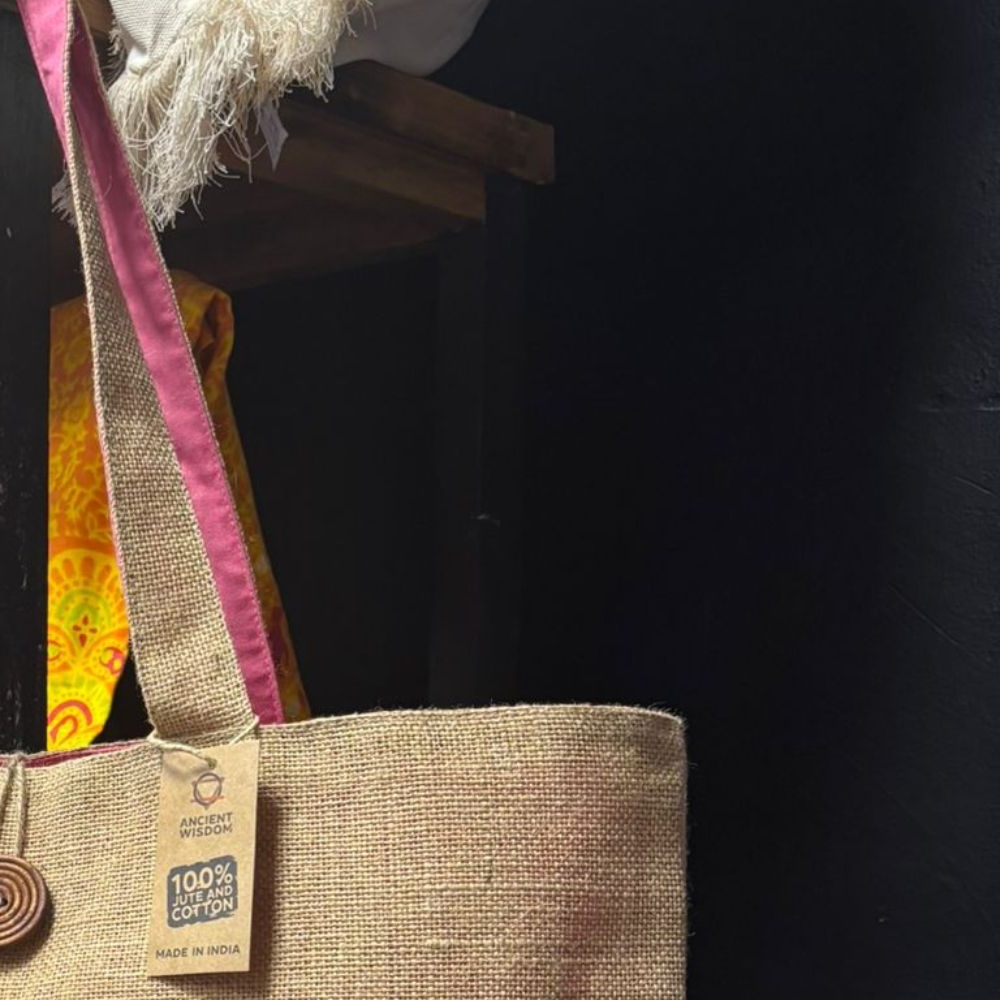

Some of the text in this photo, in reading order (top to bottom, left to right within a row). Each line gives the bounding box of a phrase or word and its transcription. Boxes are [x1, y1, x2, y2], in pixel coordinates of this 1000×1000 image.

[180, 812, 233, 828] ANCIENT
[179, 823, 233, 839] WISDOM
[171, 862, 233, 893] 100%
[172, 884, 233, 908] JUTE AND
[171, 896, 234, 922] COTTON
[155, 944, 240, 959] MADE IN INDIA
